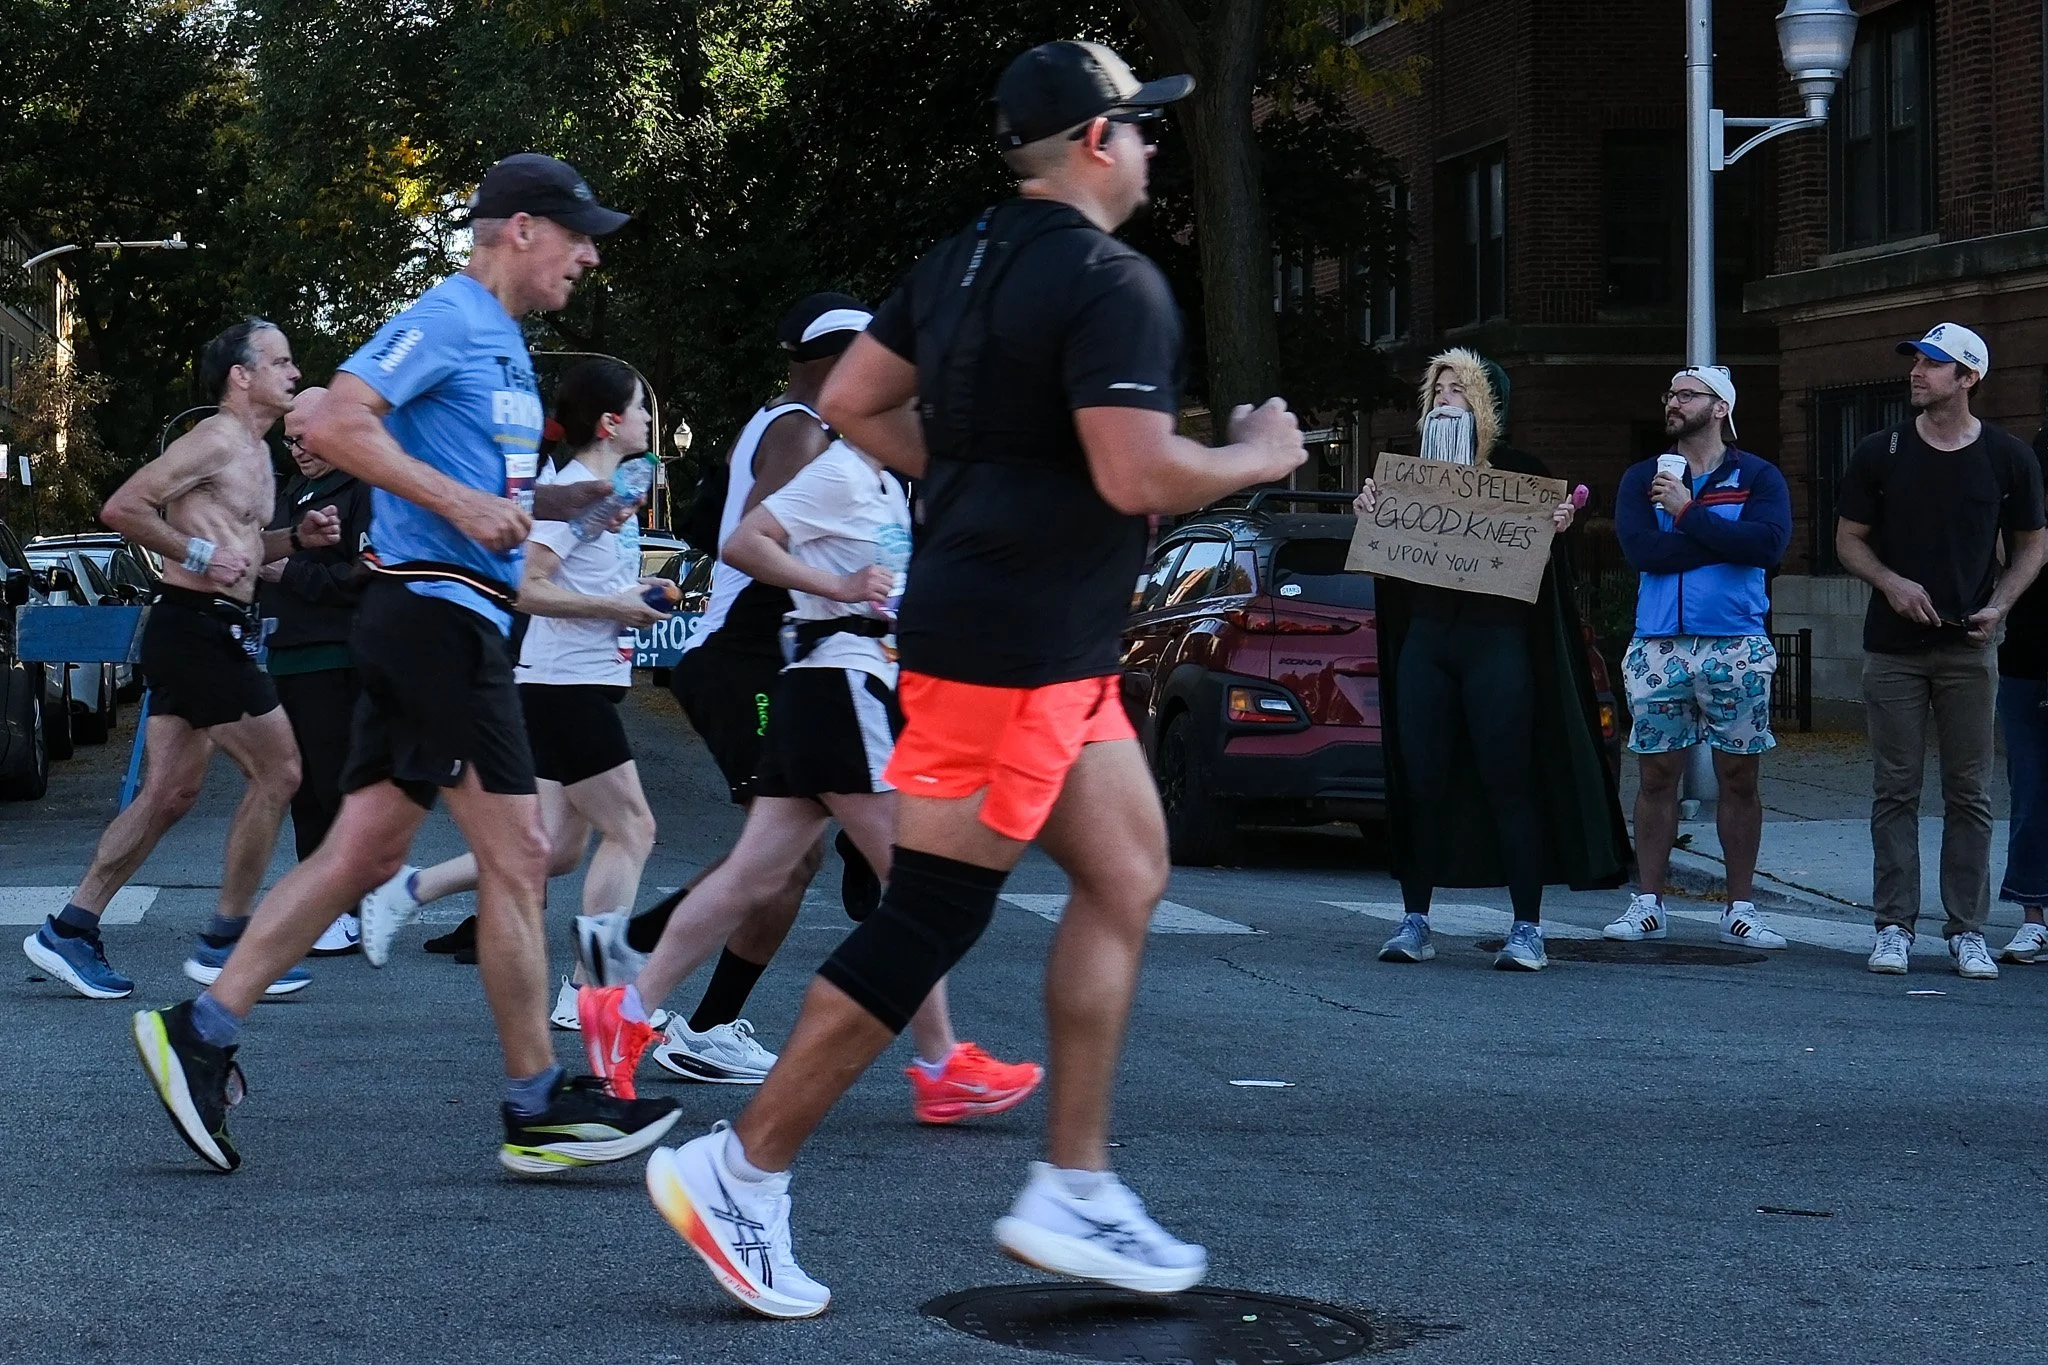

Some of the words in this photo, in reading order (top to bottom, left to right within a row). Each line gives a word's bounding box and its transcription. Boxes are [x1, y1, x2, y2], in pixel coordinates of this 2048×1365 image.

[1383, 461, 1389, 481] I
[1395, 462, 1438, 485] CAST
[1439, 469, 1451, 487] A
[1539, 489, 1565, 505] OF
[1375, 496, 1462, 535] GOOD
[1463, 511, 1538, 550] KNEES
[1388, 545, 1438, 567] UPON
[1445, 554, 1480, 573] YOU!
[1279, 658, 1322, 666] KONA
